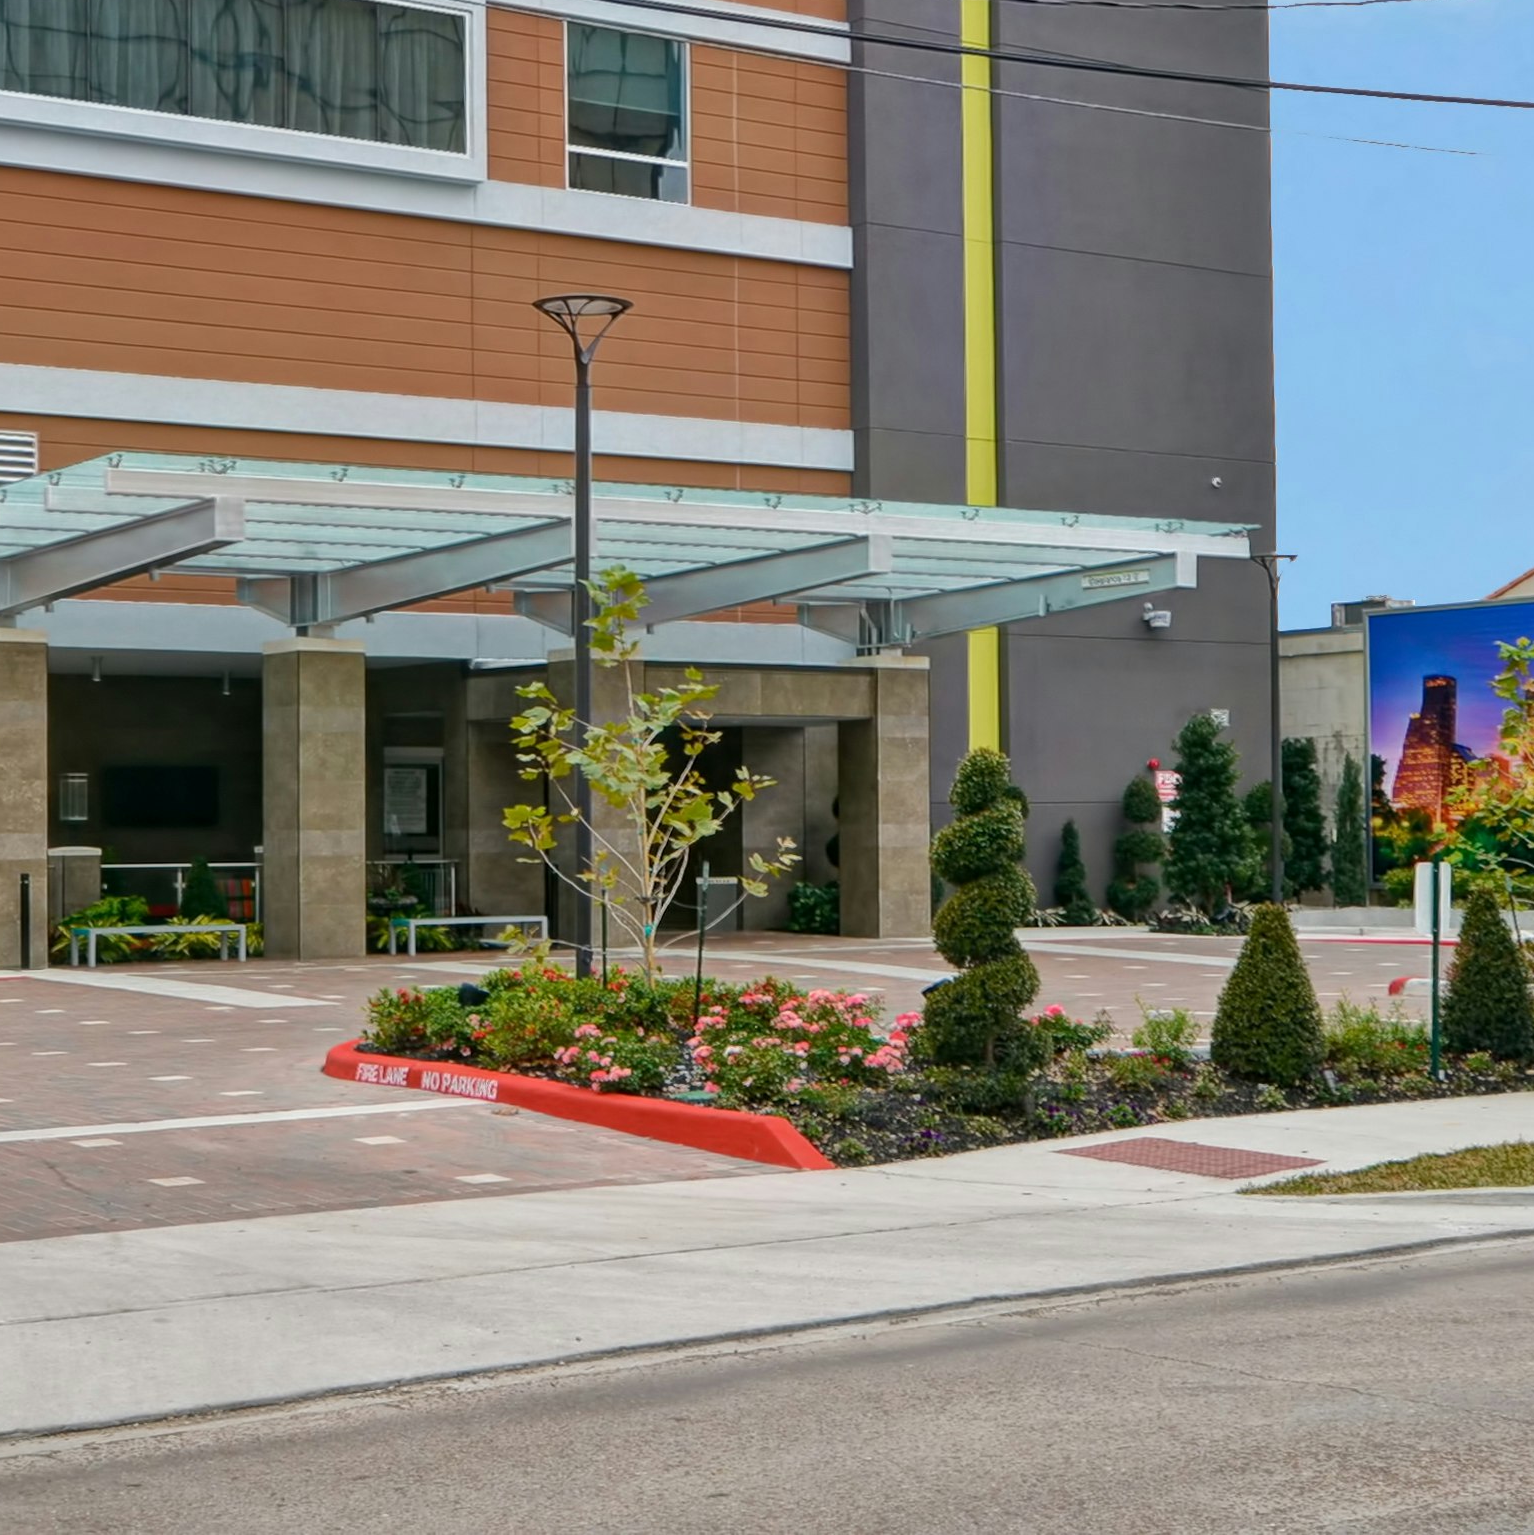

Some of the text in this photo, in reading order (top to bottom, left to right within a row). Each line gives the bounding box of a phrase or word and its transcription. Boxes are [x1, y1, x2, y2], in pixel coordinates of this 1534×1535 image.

[355, 1063, 499, 1100] FIRE LANE NO PARKING
